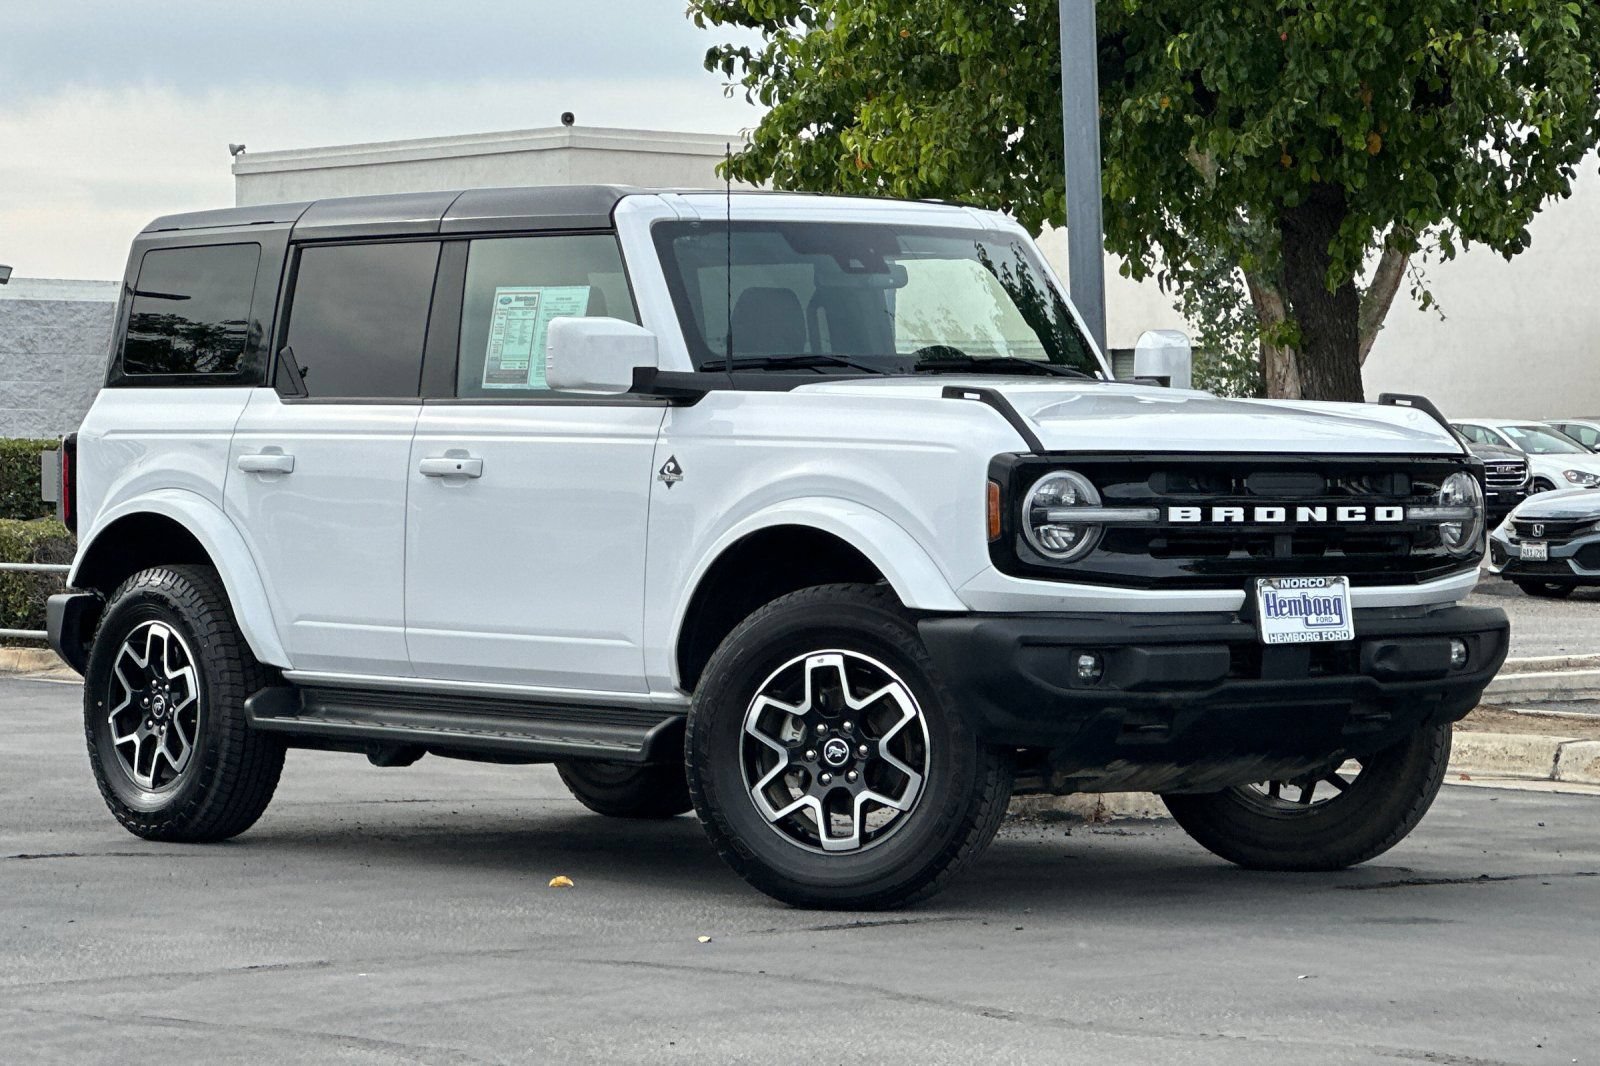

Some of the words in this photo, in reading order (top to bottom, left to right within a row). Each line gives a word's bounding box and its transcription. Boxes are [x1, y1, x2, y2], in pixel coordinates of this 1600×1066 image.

[1168, 506, 1404, 523] BRONCO
[1280, 578, 1326, 589] NORCO
[1270, 632, 1321, 644] HEMBORG
[1322, 630, 1349, 641] FORD
